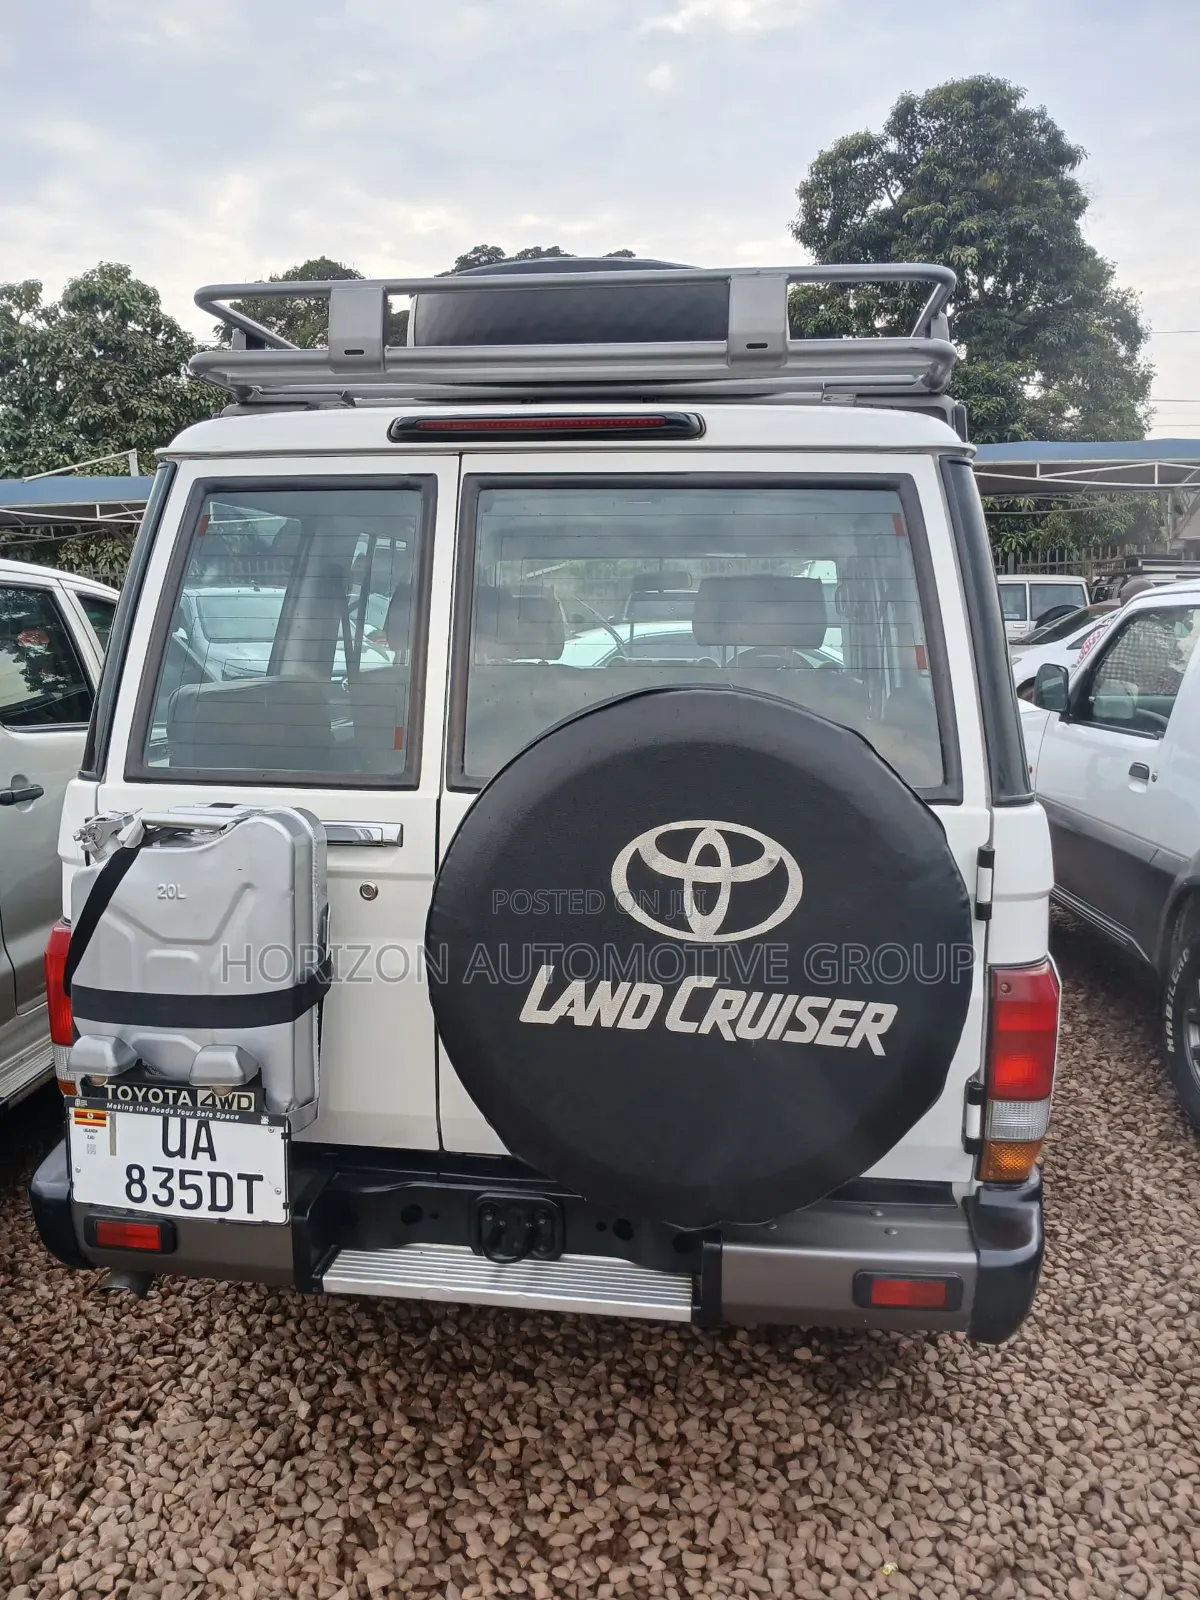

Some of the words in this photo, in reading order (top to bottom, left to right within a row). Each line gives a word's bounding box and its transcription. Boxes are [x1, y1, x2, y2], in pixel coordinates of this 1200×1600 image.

[156, 883, 187, 901] 20L
[519, 965, 671, 1030] LAND
[664, 975, 899, 1056] CRUISER
[105, 1084, 193, 1107] TOYOTA
[198, 1090, 254, 1113] 4WD
[106, 1102, 134, 1113] Making
[136, 1104, 149, 1113] the
[150, 1106, 174, 1115] Roads
[176, 1107, 195, 1117] Your
[196, 1110, 214, 1119] Safe
[215, 1111, 240, 1121] Space
[161, 1116, 217, 1162] UA
[125, 1163, 264, 1215] 835DT
